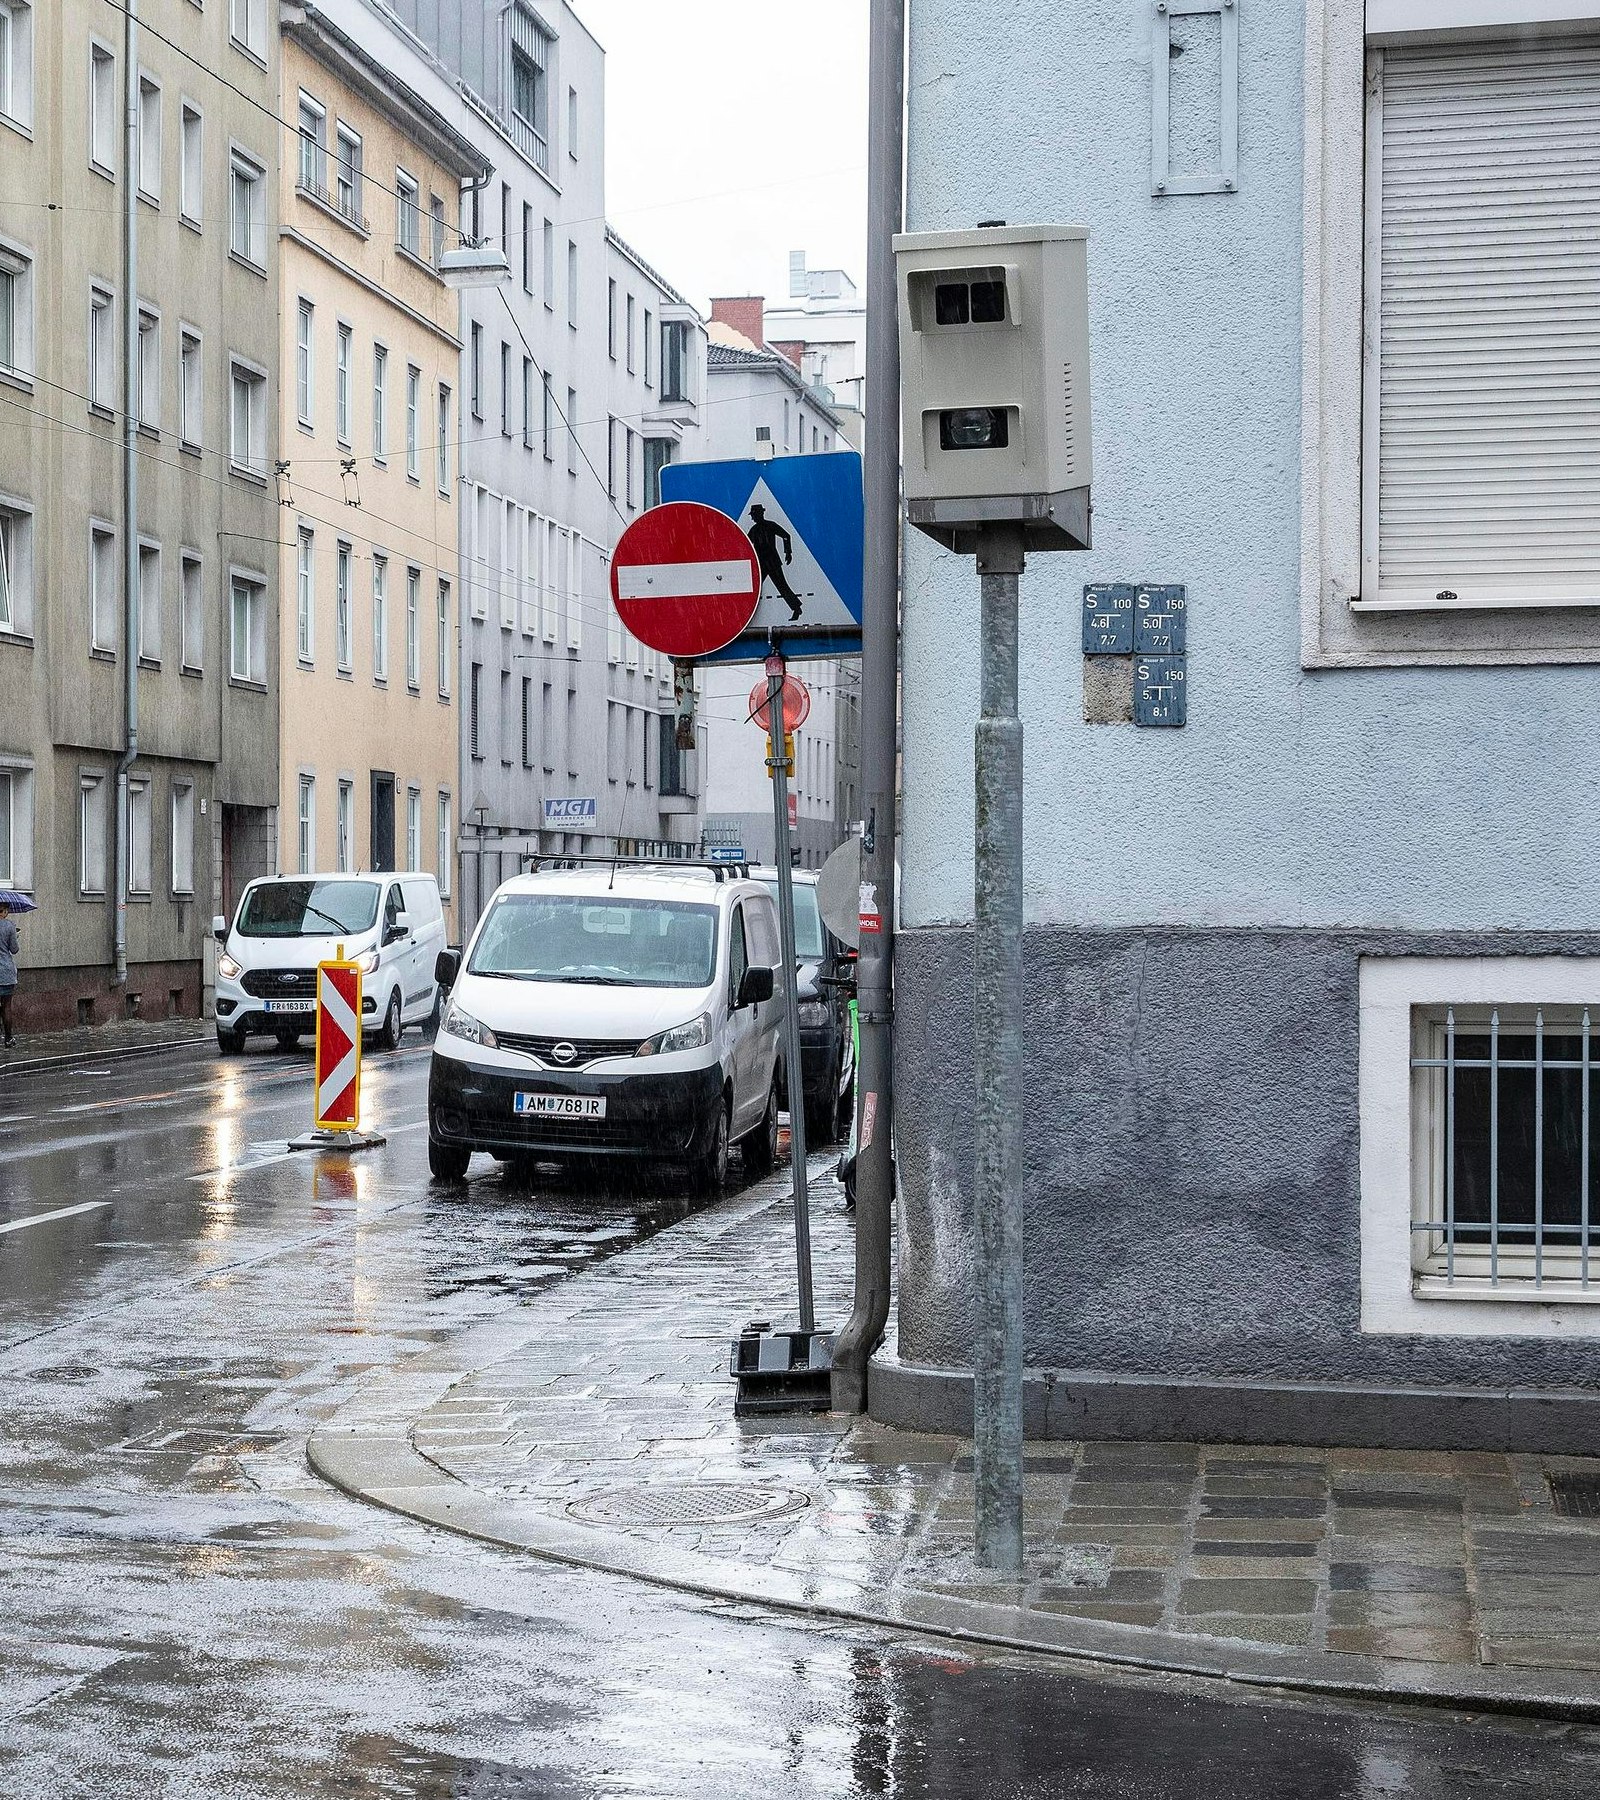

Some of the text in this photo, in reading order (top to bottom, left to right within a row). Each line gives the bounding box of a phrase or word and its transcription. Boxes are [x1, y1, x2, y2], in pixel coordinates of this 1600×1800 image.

[1086, 594, 1132, 608] S 100
[1138, 594, 1184, 609] S 150
[1138, 666, 1184, 681] S 150
[549, 800, 591, 816] MGI
[527, 1097, 599, 1114] AM 768 IR
